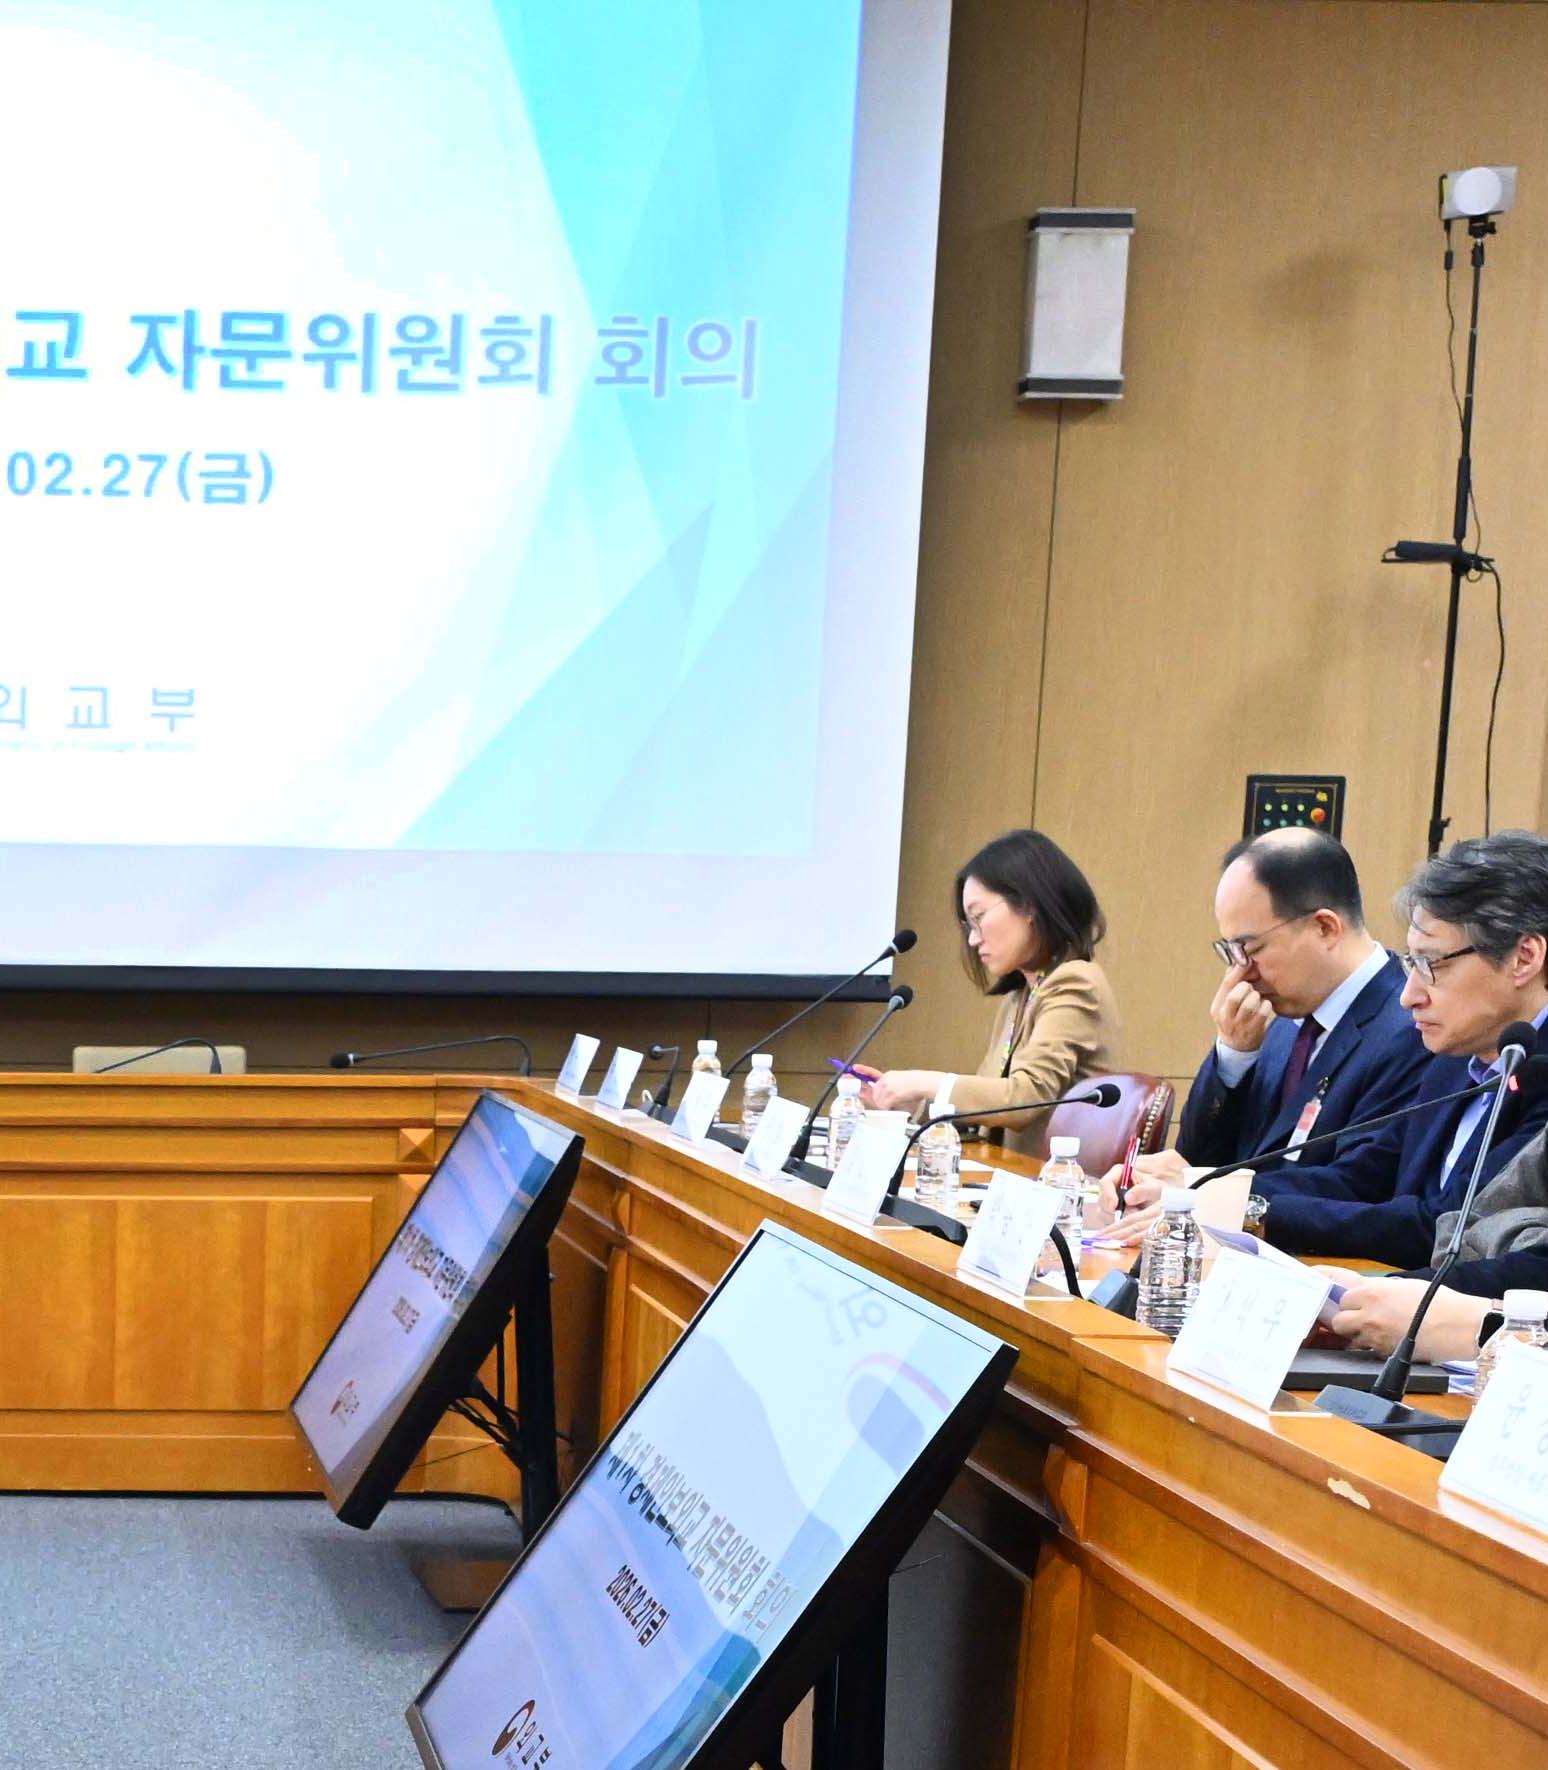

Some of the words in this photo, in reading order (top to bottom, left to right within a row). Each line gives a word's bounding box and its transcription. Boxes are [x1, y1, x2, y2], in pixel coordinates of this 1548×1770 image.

[126, 310, 554, 396] 자문위원회
[594, 316, 756, 400] 회의
[606, 1564, 671, 1649] 2026.02.27(금)
[686, 1514, 771, 1618] 자문위원회
